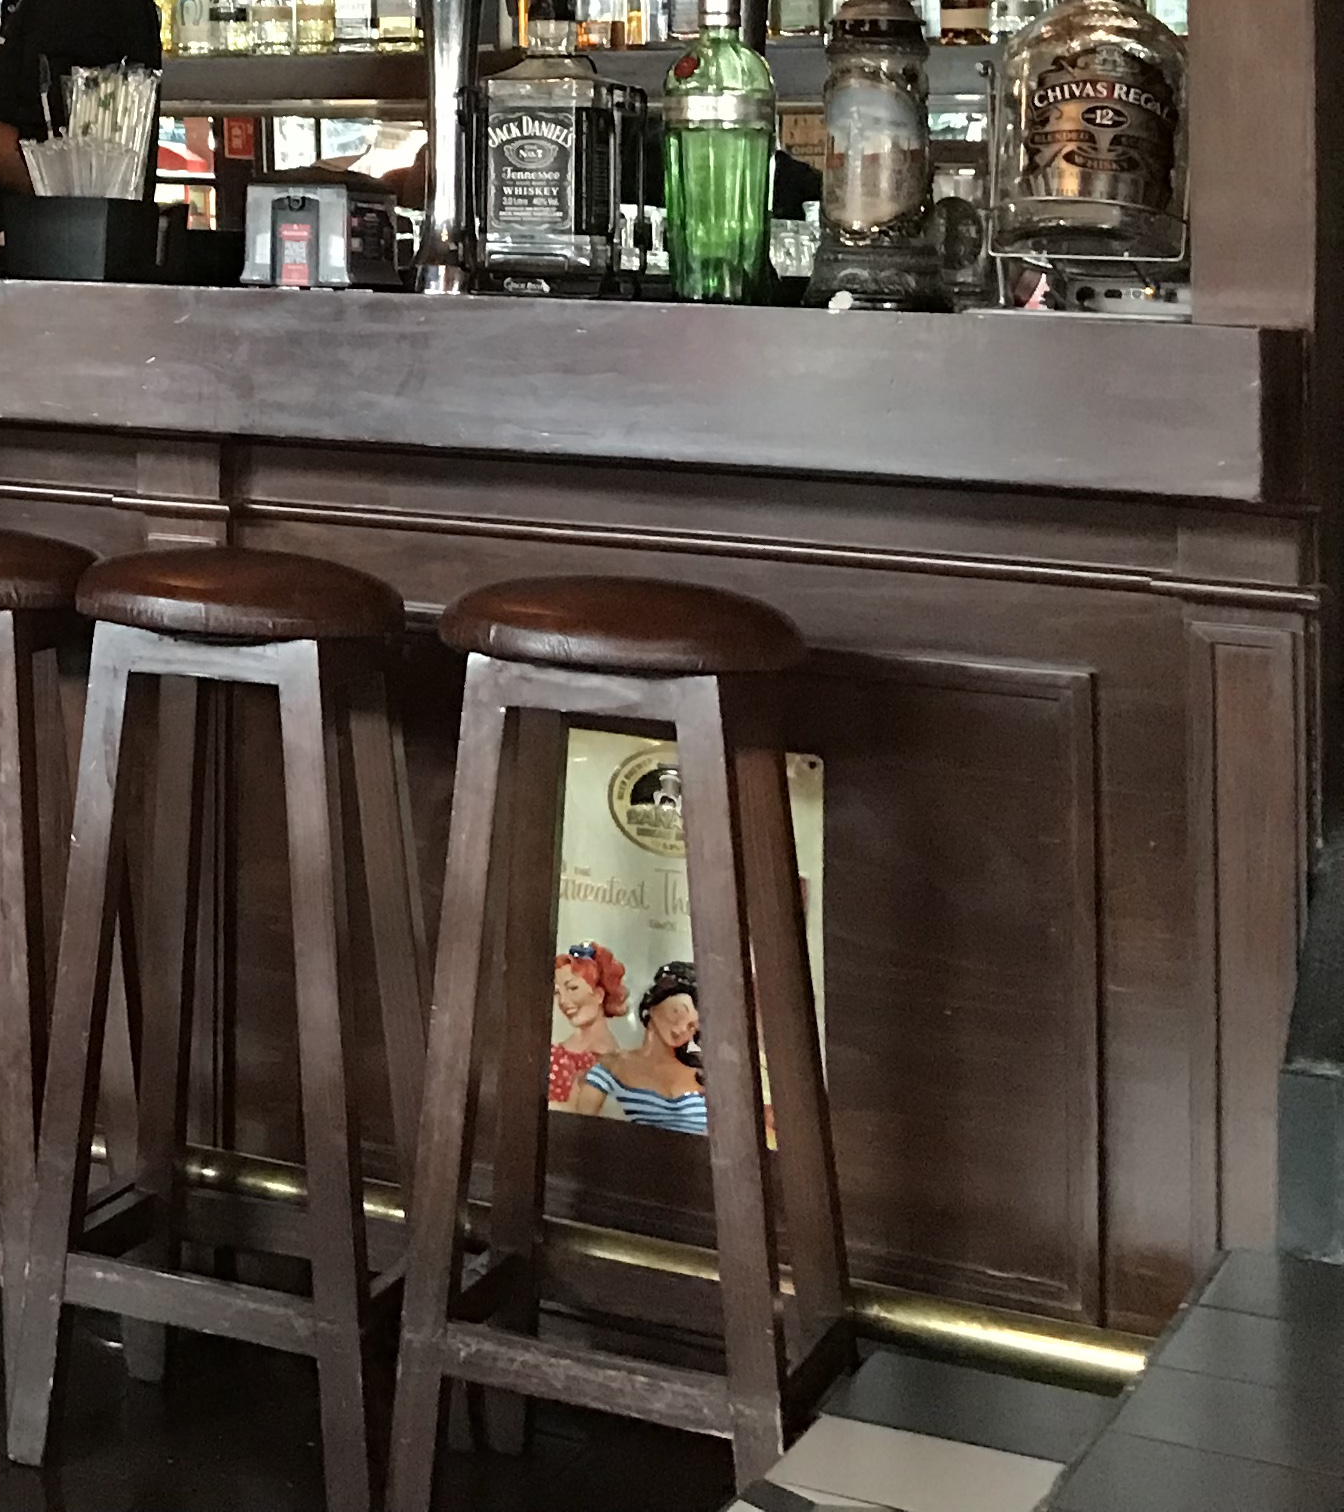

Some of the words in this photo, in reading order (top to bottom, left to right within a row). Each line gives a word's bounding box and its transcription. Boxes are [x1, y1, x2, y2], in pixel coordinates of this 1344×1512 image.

[1033, 81, 1108, 108] CHIVAS
[1113, 82, 1170, 121] REGAL
[1094, 109, 1114, 125] 12
[488, 122, 521, 148] JACK
[522, 115, 575, 148] DANIEL'S
[502, 167, 560, 180] Tennessee
[502, 186, 560, 196] WHISKEY
[627, 805, 684, 830] BAVA
[654, 868, 690, 916] Th
